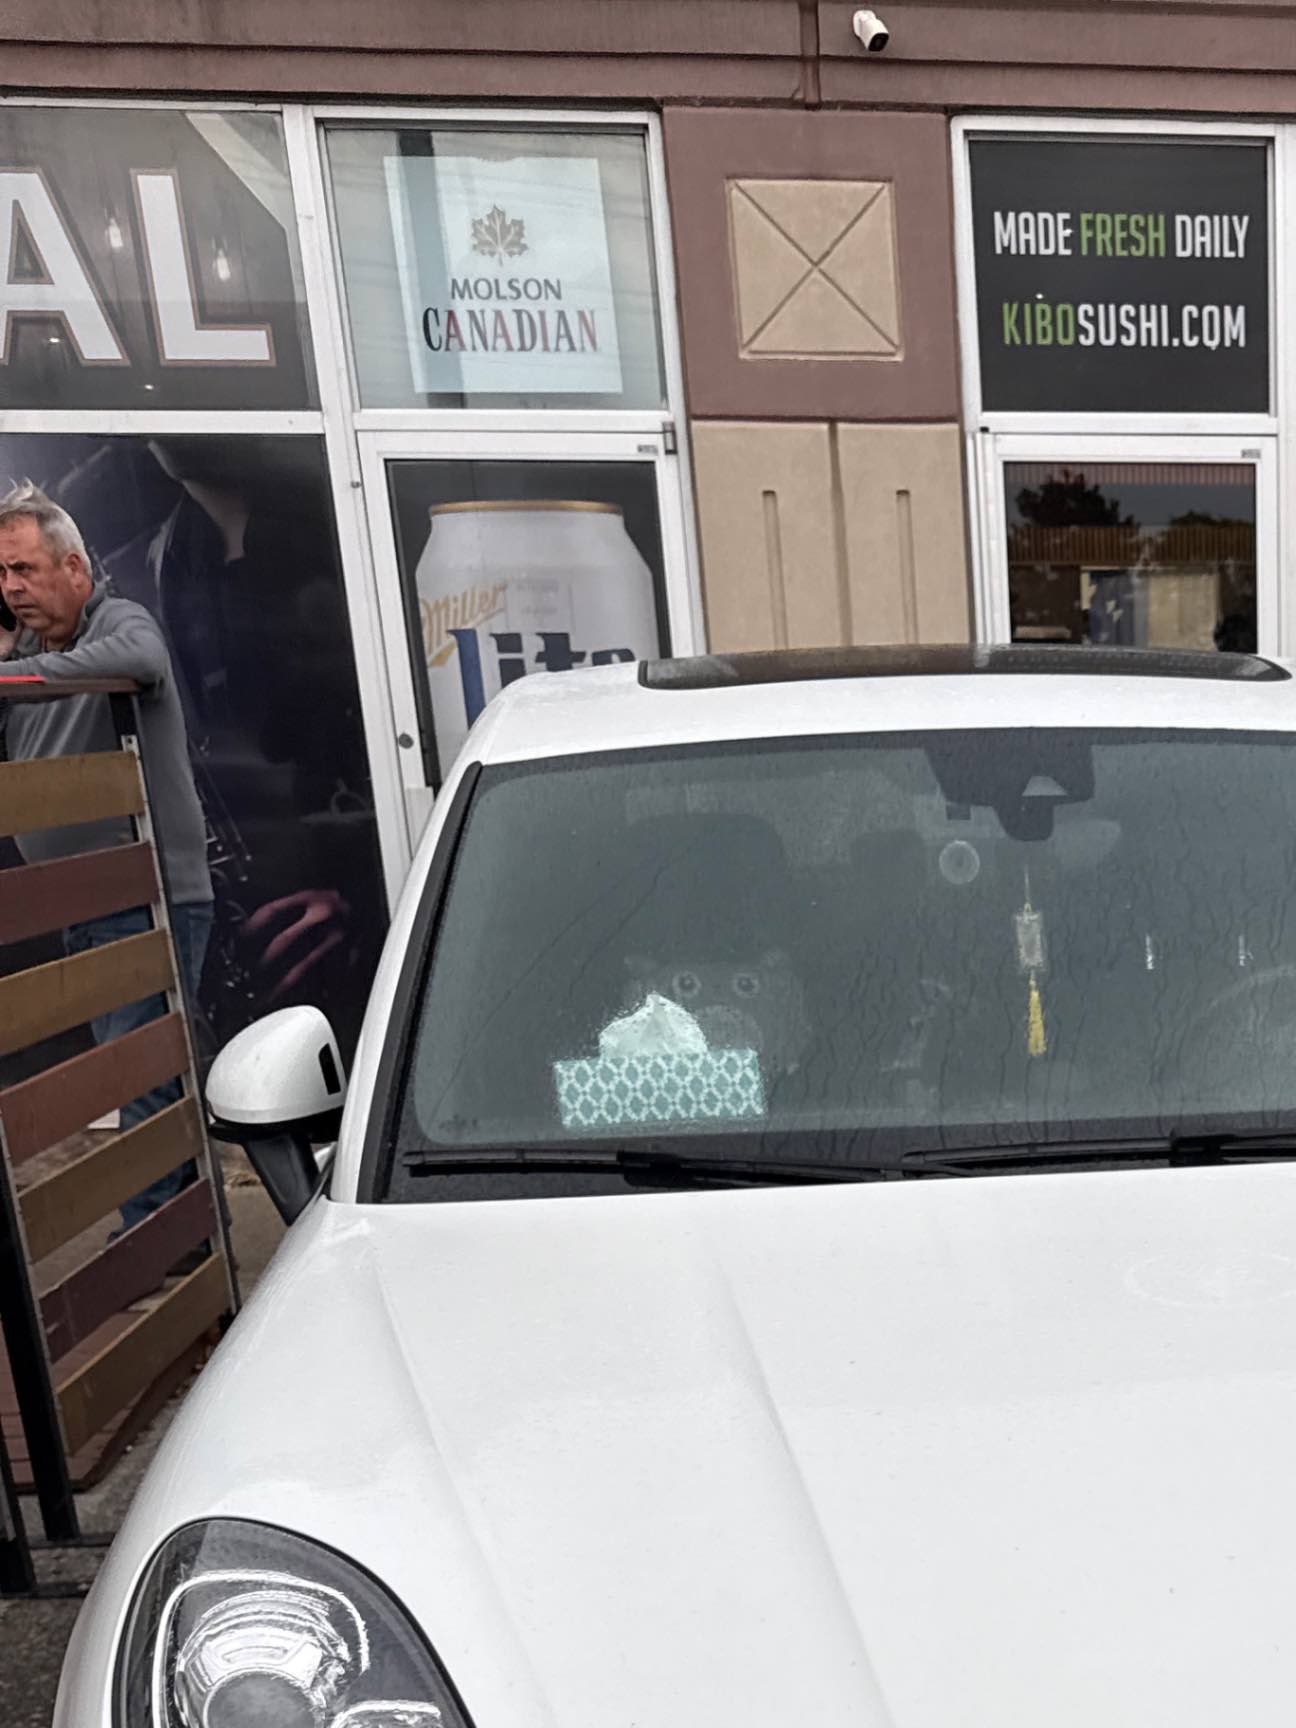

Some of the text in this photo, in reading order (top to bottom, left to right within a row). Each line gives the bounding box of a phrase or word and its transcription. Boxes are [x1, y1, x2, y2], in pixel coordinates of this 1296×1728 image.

[993, 211, 1249, 258] MADE FRESH DAILY
[0, 166, 276, 366] AL
[451, 278, 562, 300] MOLSON
[422, 306, 598, 352] CANADIAN
[1002, 302, 1246, 348] KIBOSUSHI.COM
